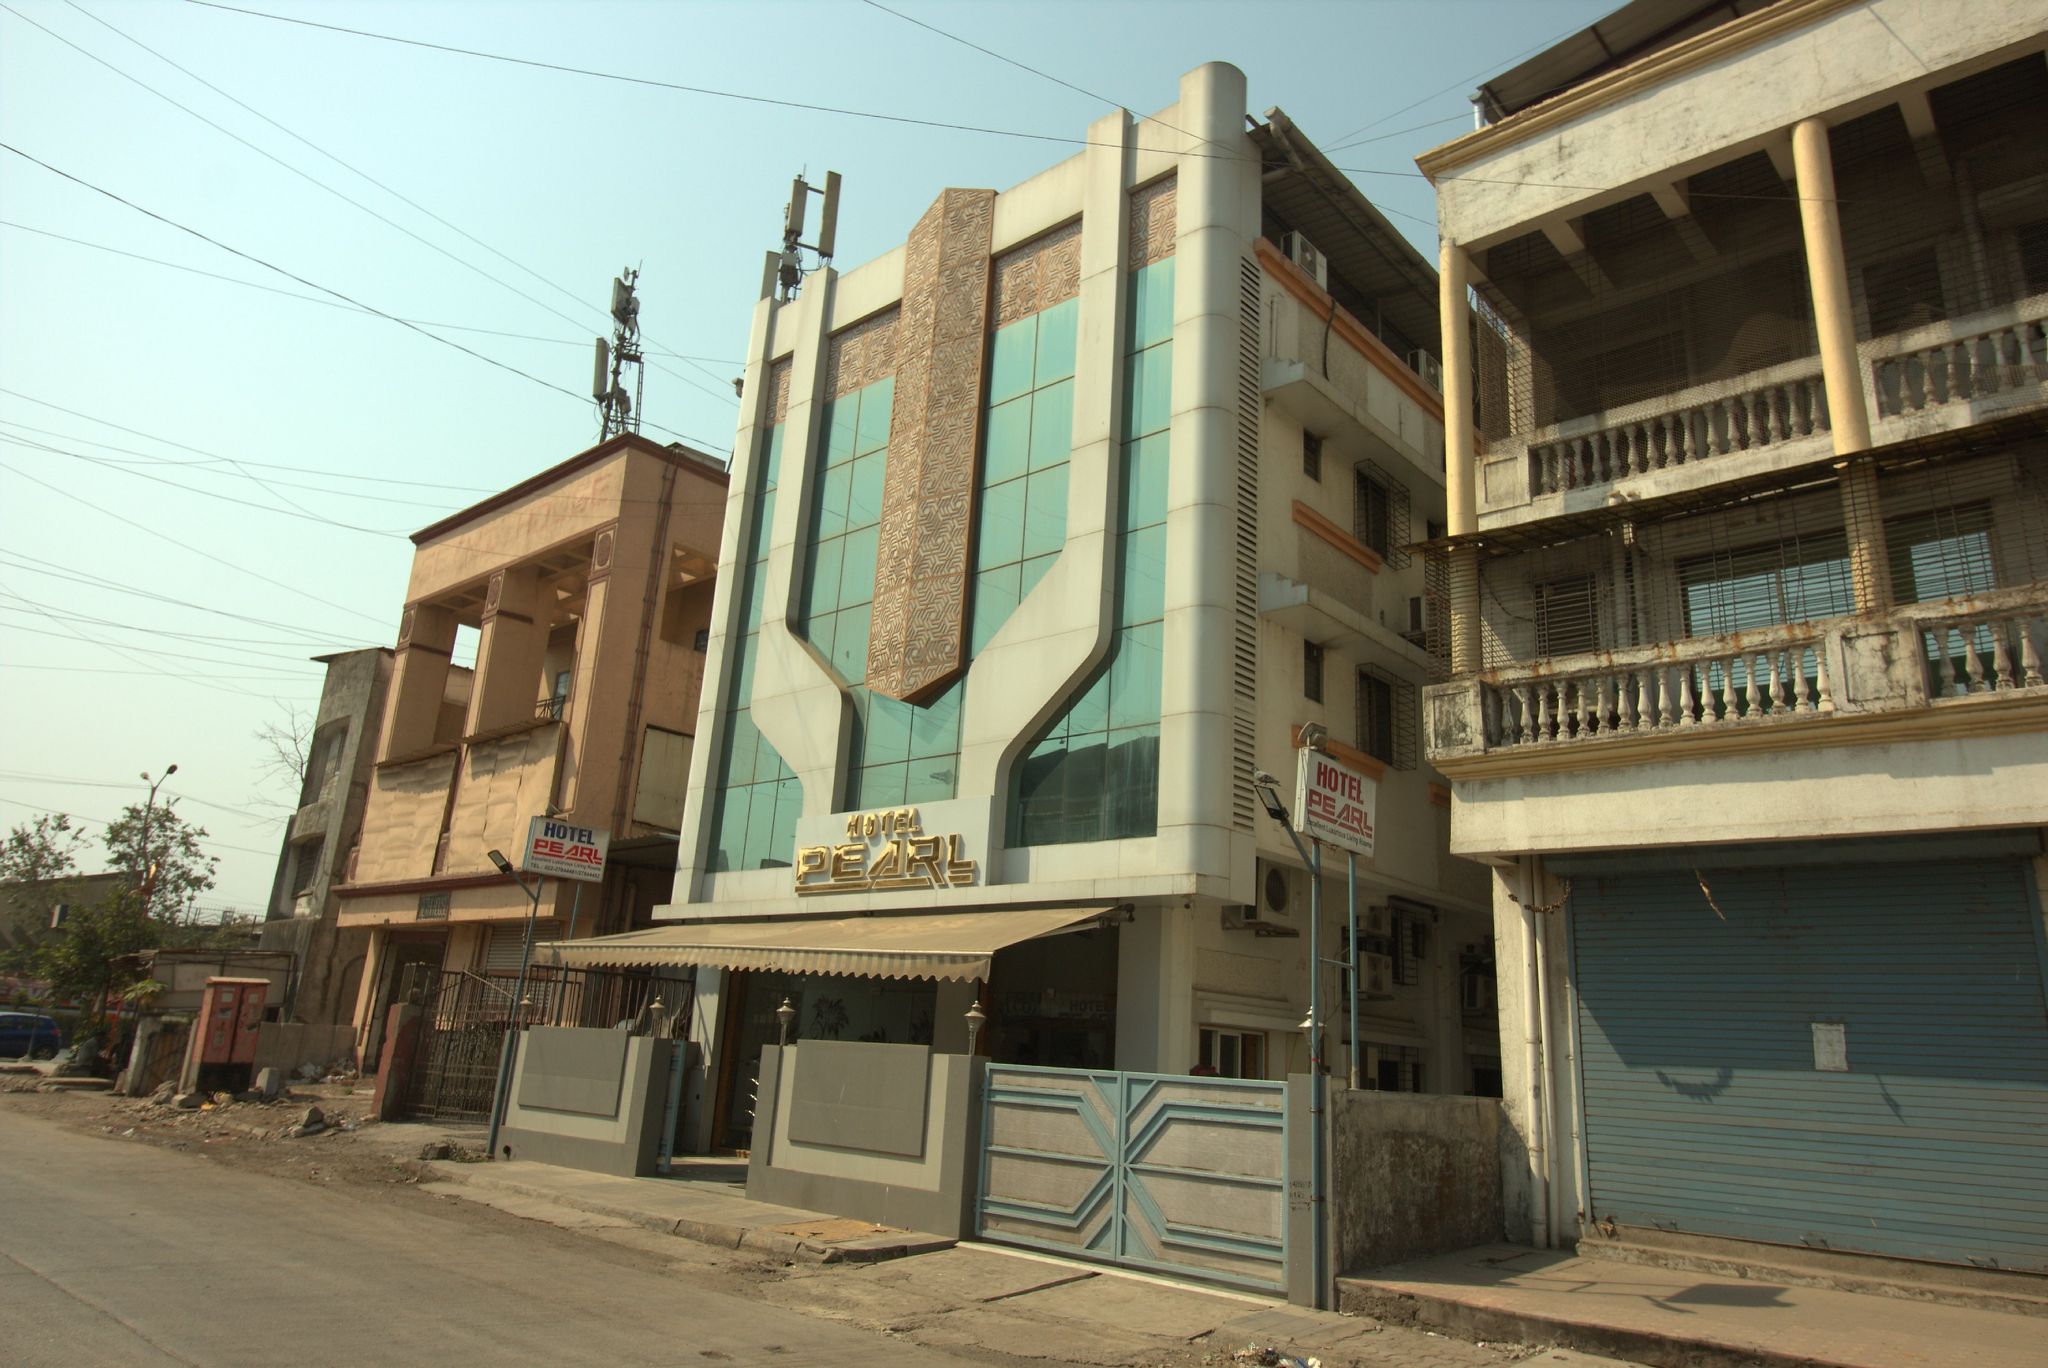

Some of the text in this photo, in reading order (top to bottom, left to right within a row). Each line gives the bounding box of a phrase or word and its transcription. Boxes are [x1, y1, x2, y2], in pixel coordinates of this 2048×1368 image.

[1316, 761, 1364, 805] HOTEL
[846, 807, 922, 838] HOTEL
[1308, 788, 1372, 839] PEARL
[533, 838, 603, 865] PEARL
[543, 821, 595, 845] HOTEL
[794, 833, 977, 895] PEARL
